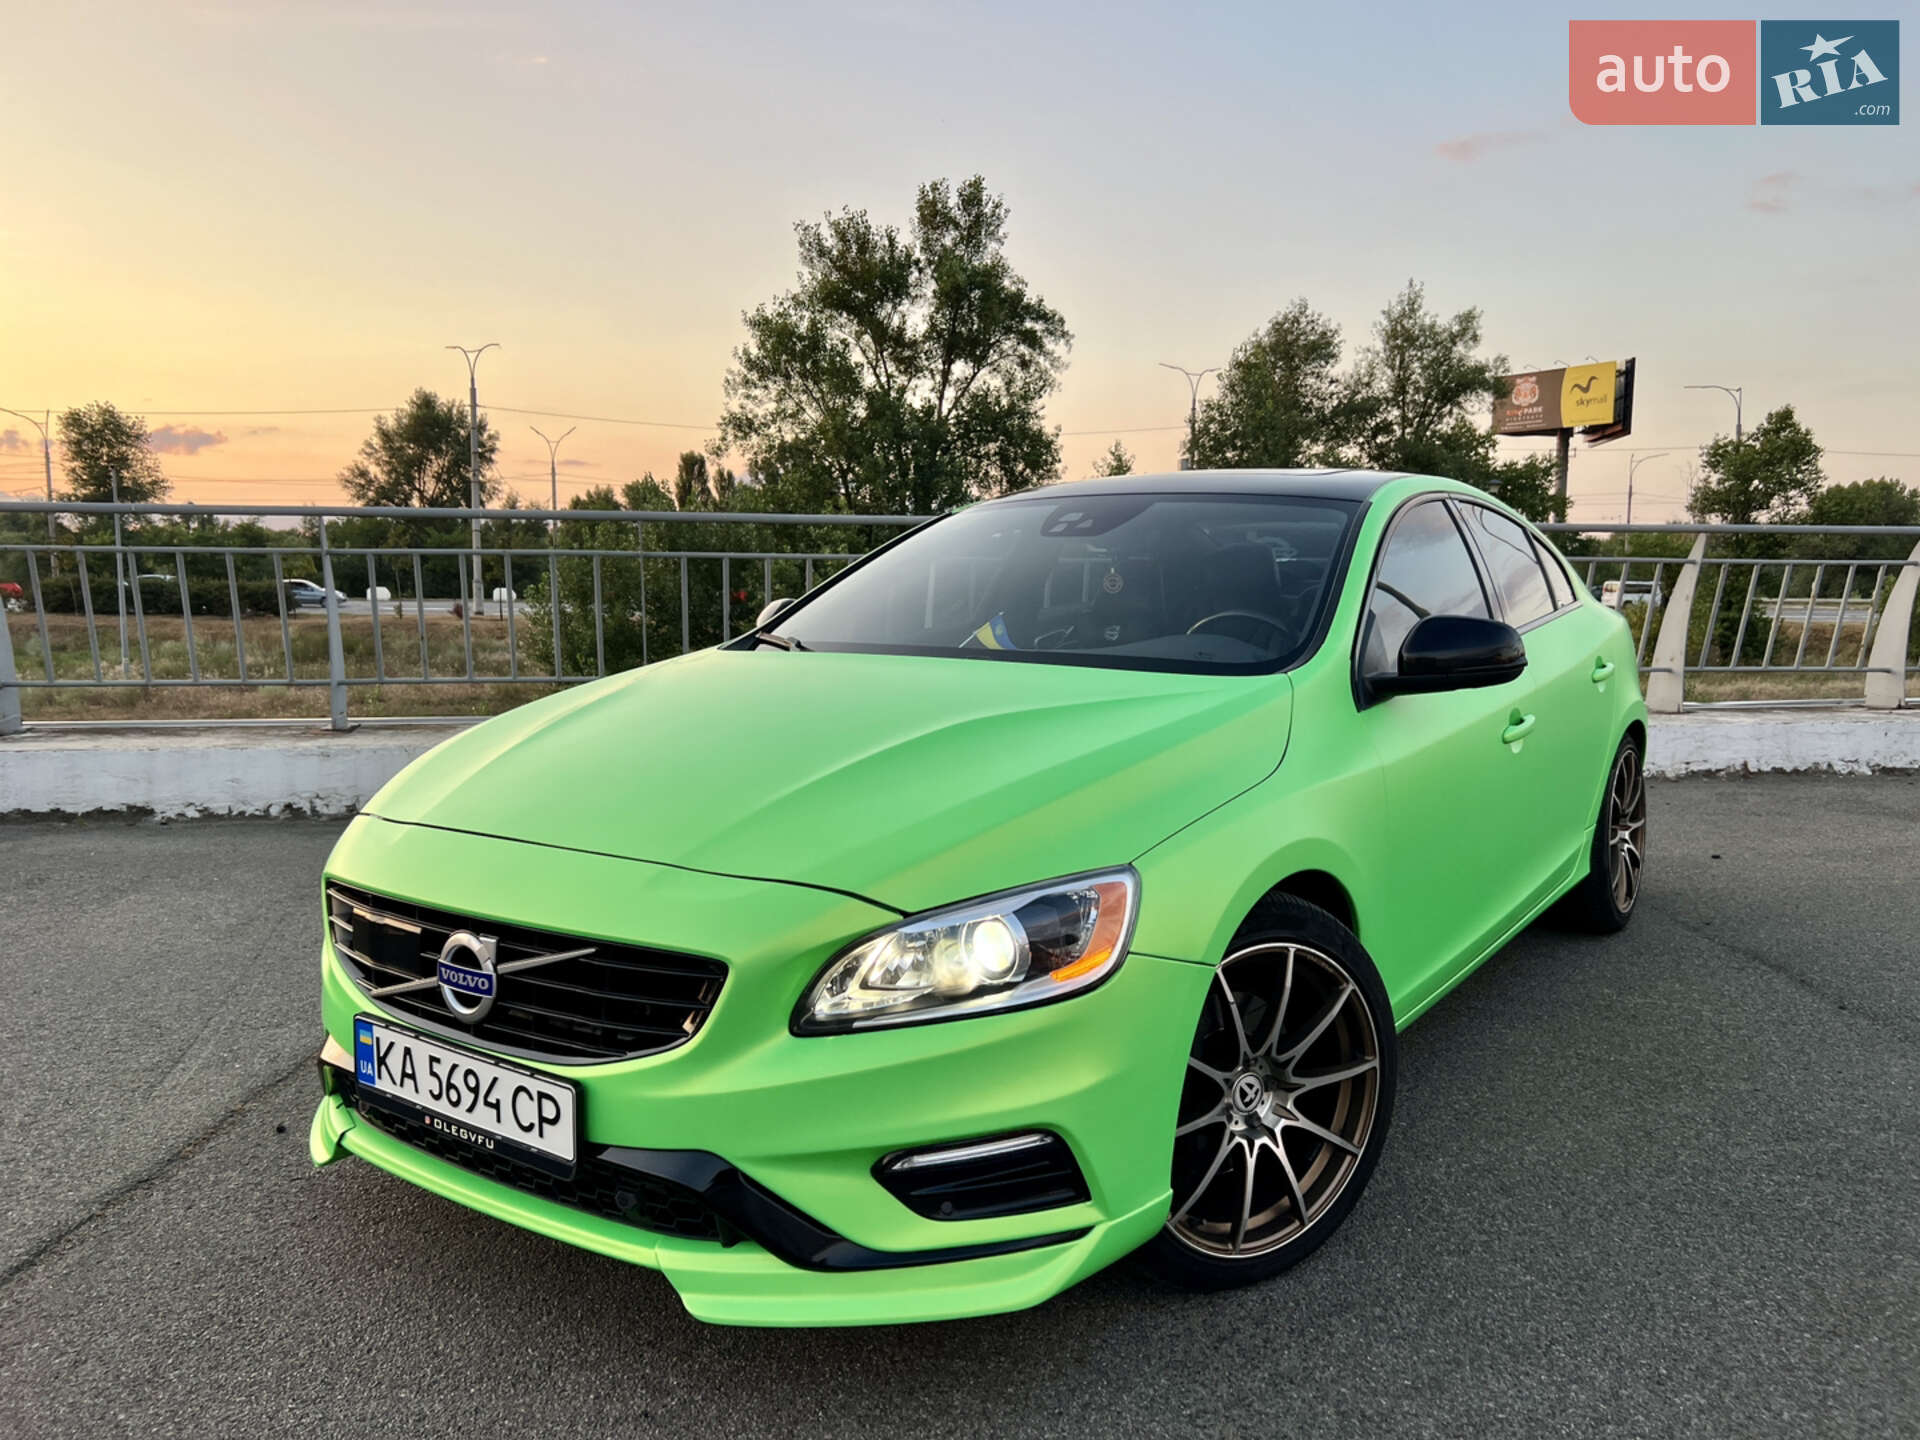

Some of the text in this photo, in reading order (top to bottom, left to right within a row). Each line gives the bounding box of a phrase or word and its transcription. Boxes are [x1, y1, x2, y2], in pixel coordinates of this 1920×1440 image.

[440, 966, 489, 991] VOLVO
[360, 1059, 374, 1077] UA
[375, 1037, 561, 1138] KA 5694 CP
